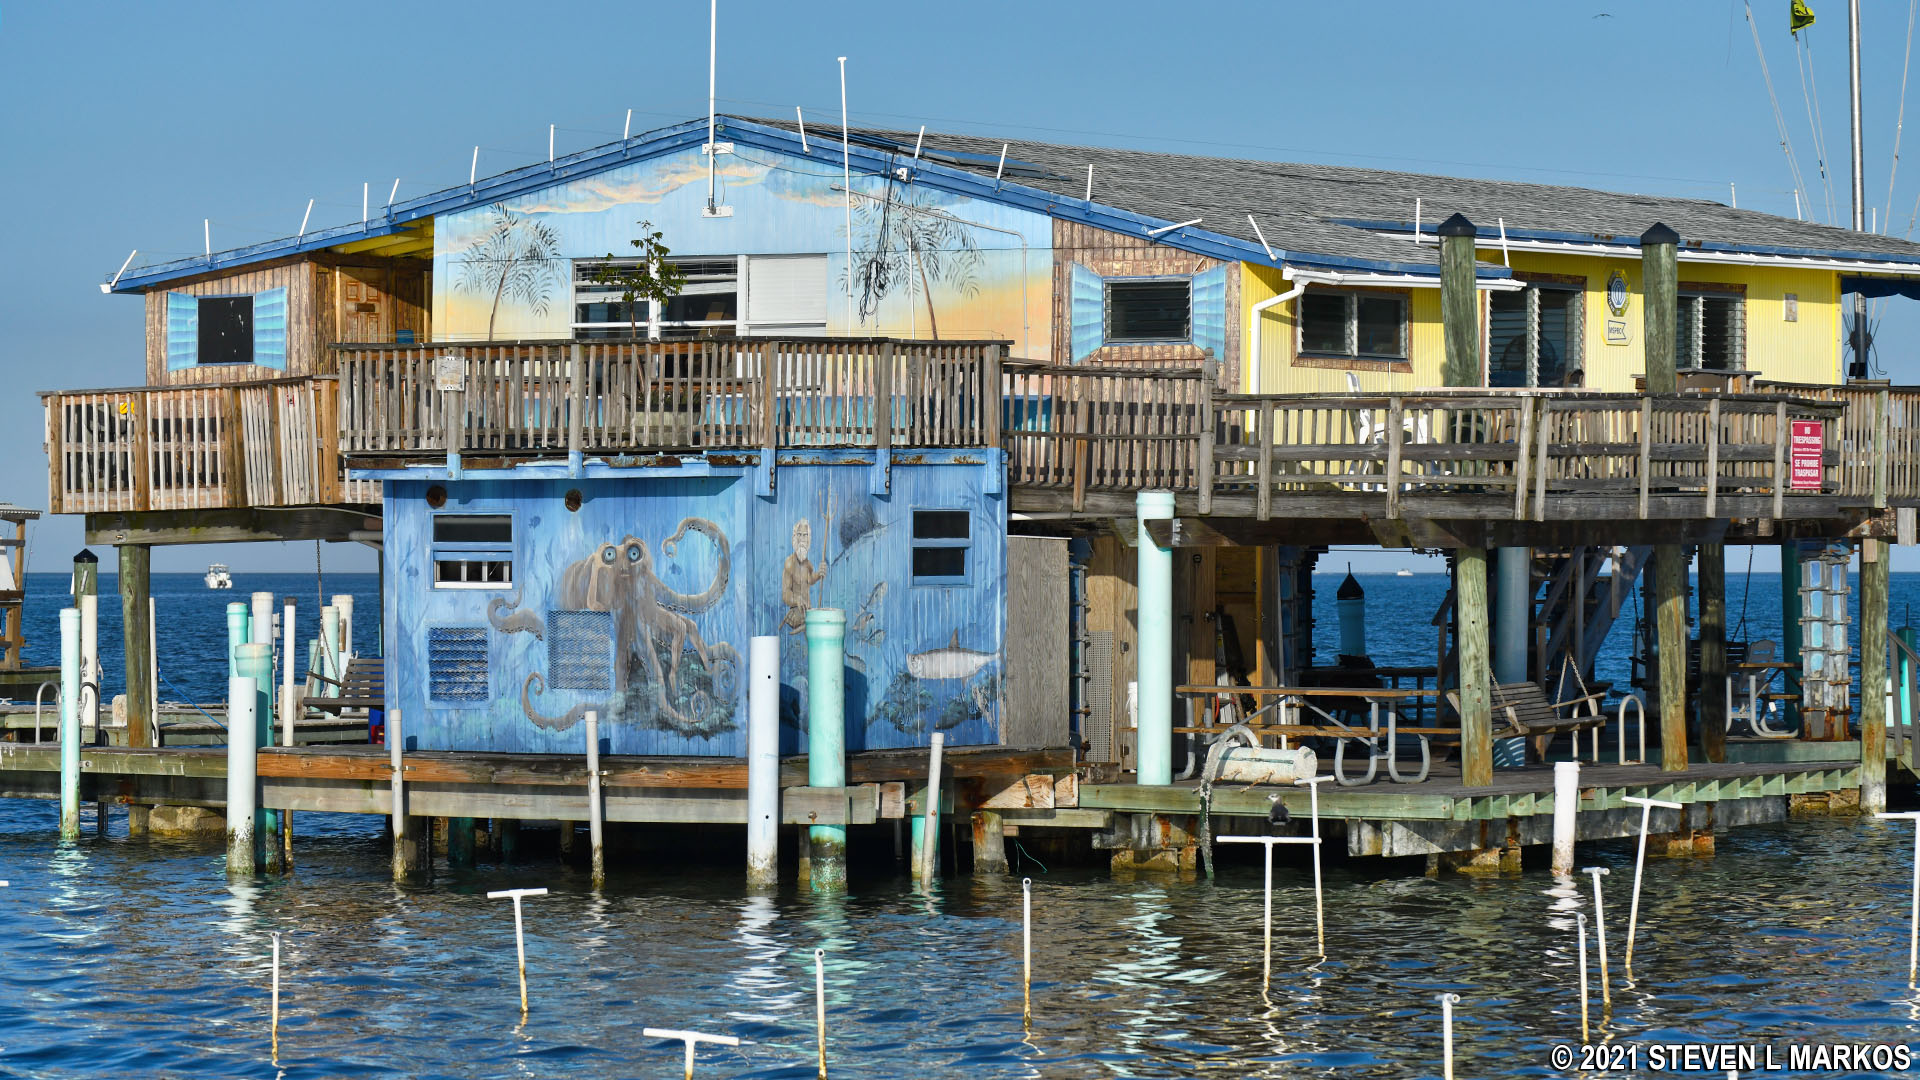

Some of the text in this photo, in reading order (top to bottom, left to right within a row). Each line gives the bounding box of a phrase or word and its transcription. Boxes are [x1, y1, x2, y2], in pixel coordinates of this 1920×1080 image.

[1804, 426, 1811, 435] NO
[1793, 435, 1821, 444] TRESPASSING
[1794, 459, 1801, 467] SE
